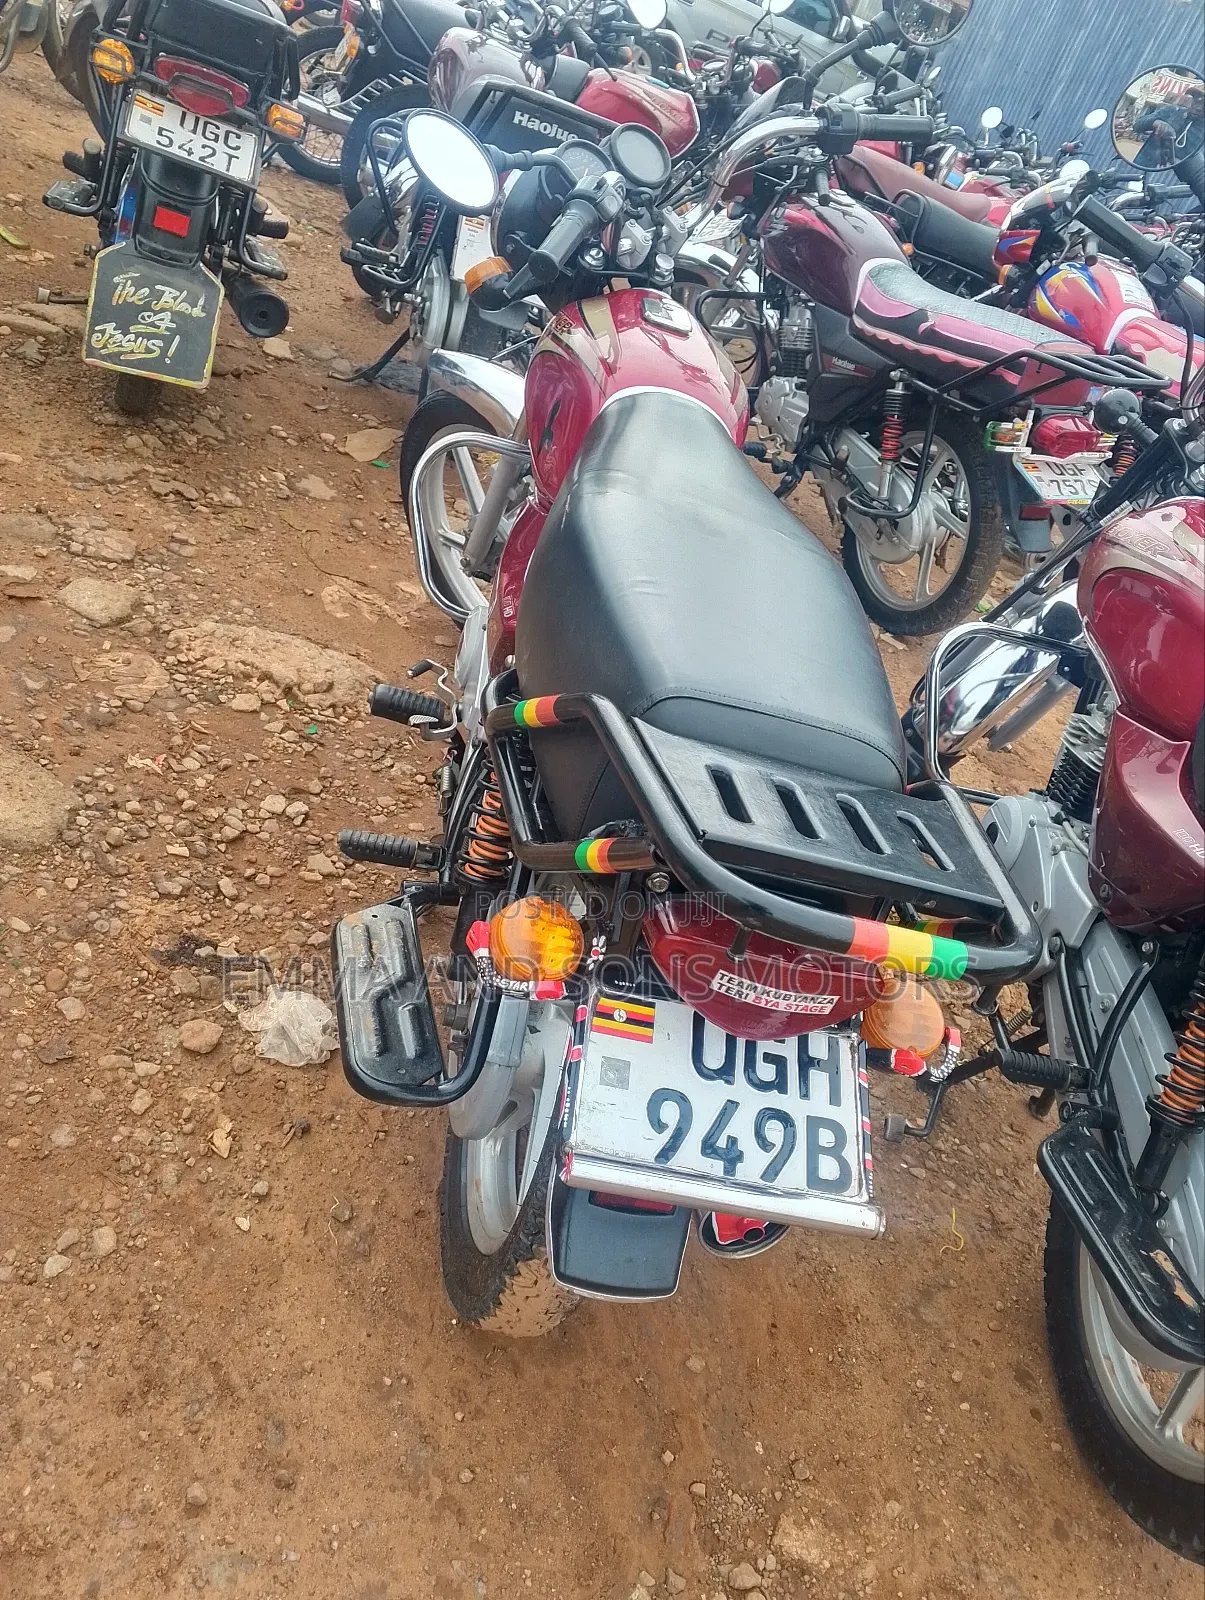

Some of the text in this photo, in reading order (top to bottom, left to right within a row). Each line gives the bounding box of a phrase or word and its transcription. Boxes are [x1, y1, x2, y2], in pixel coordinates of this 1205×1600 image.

[156, 126, 240, 173] 542T
[179, 110, 242, 151] UGC
[112, 272, 152, 305] The
[716, 981, 829, 1014] TERI BYA STAGE
[719, 971, 836, 1006] TEAM KUBYANZA
[691, 1009, 843, 1108] UGH
[646, 1087, 853, 1195] 949B
